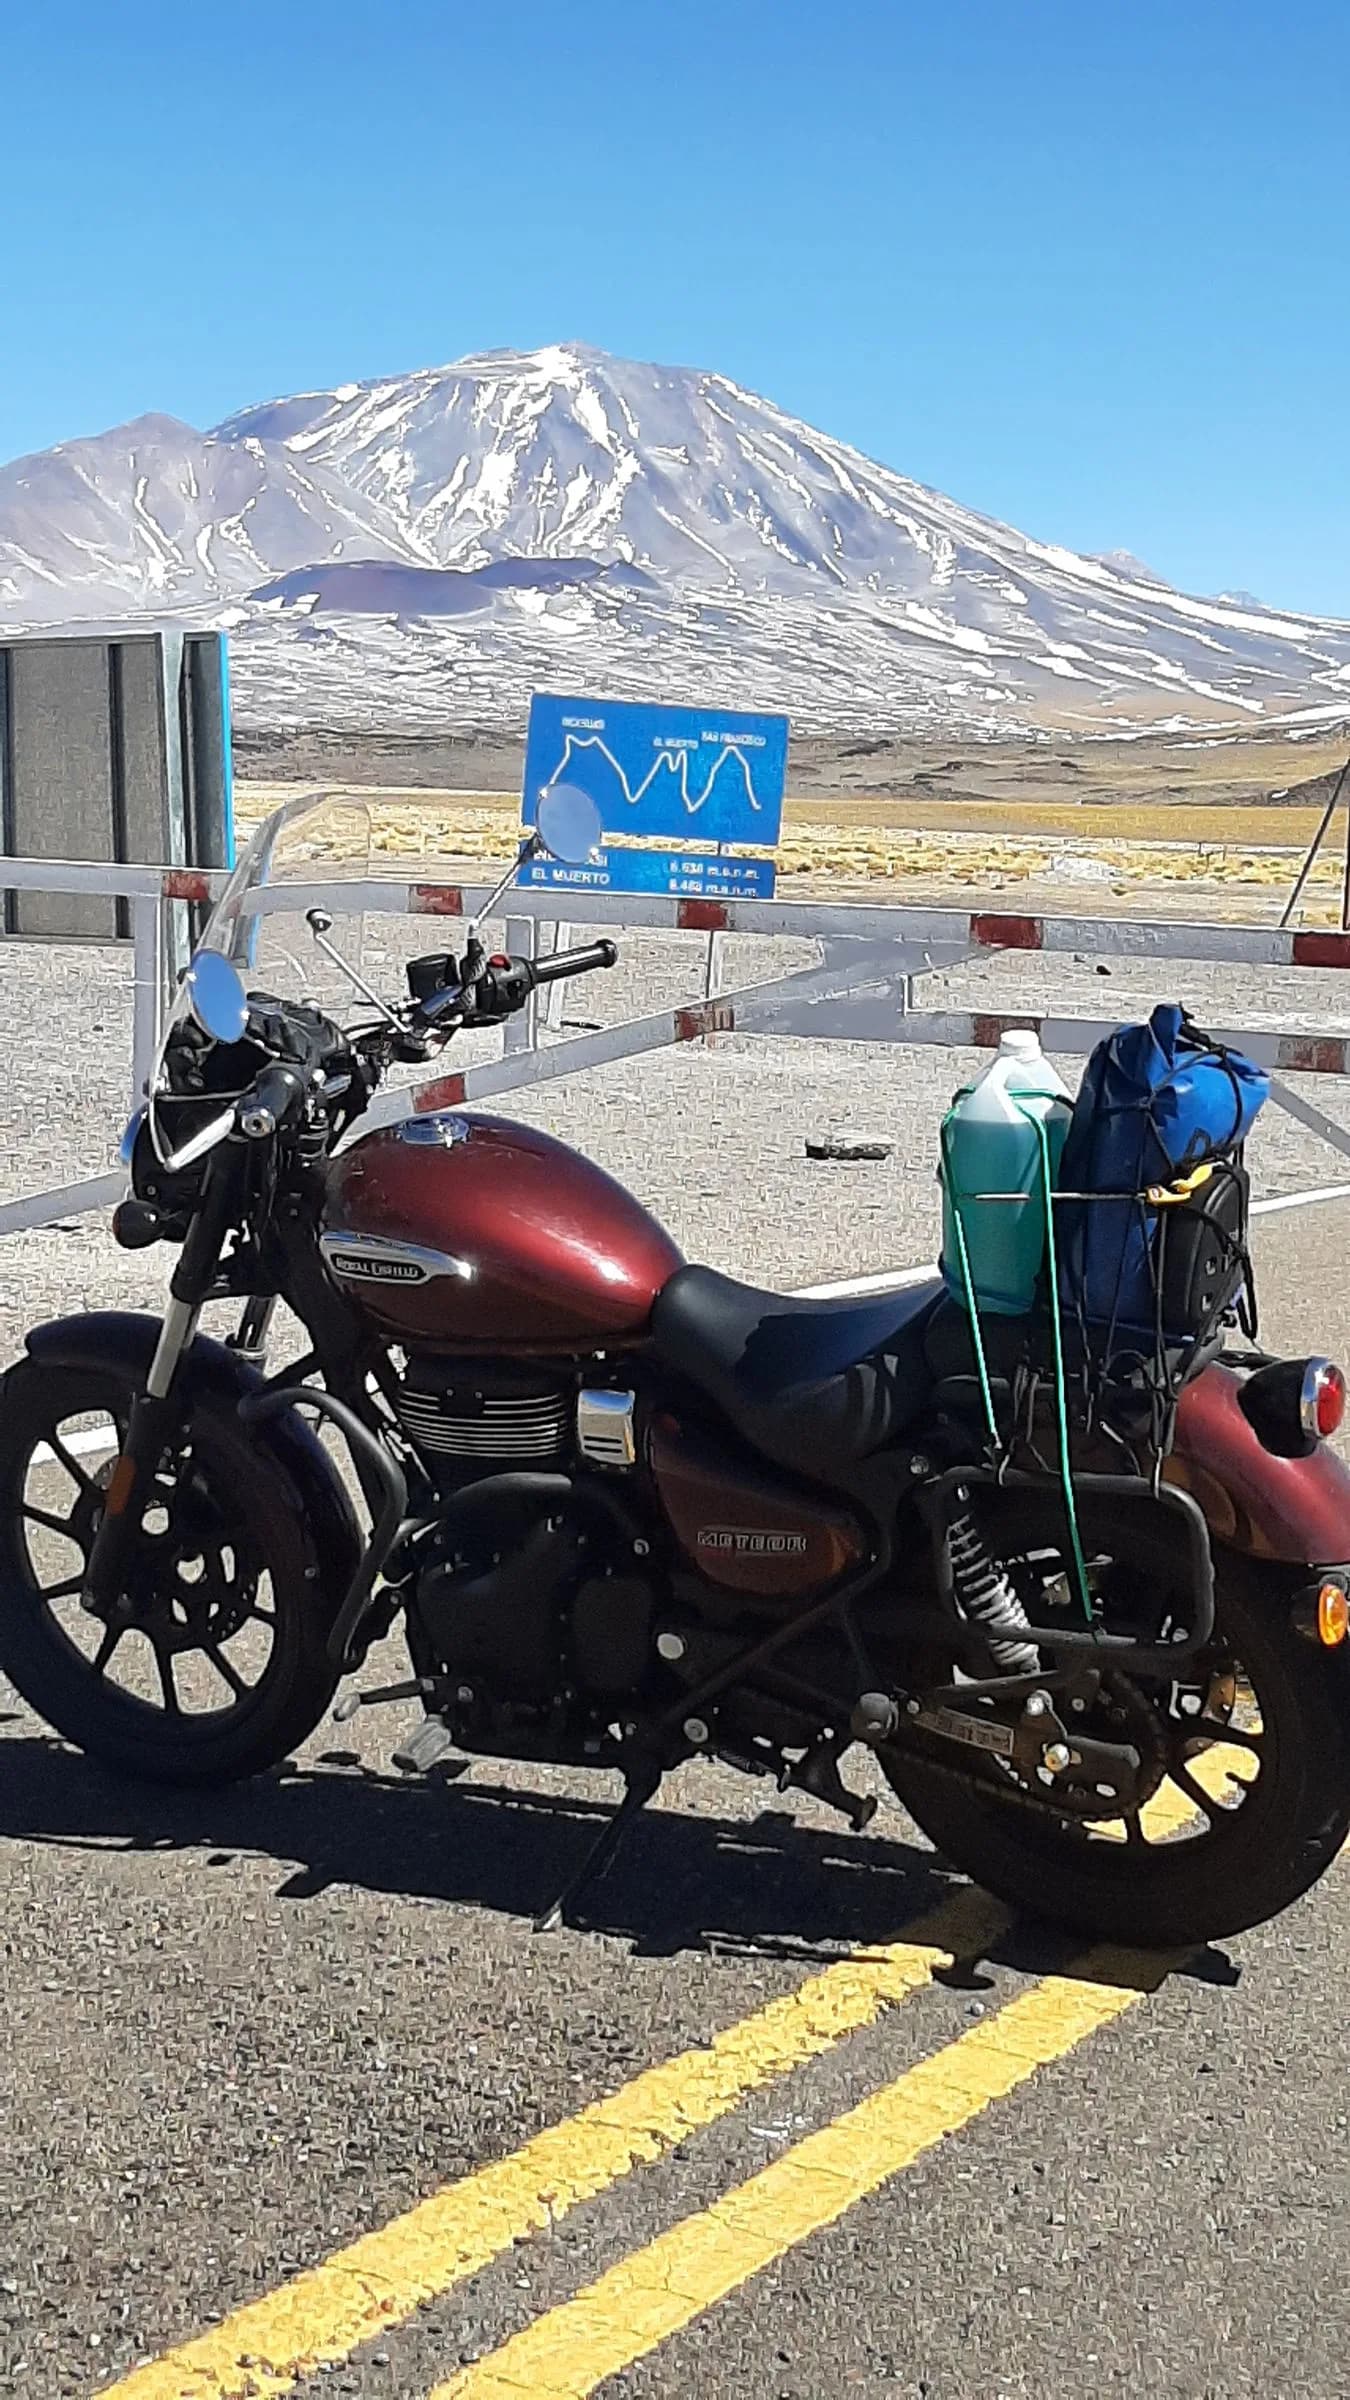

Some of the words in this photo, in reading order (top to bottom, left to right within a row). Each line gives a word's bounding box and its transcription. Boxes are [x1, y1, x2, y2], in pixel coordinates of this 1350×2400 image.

[532, 867, 549, 880] EL
[552, 869, 611, 885] MUERTO
[697, 1530, 808, 1552] METEOR
